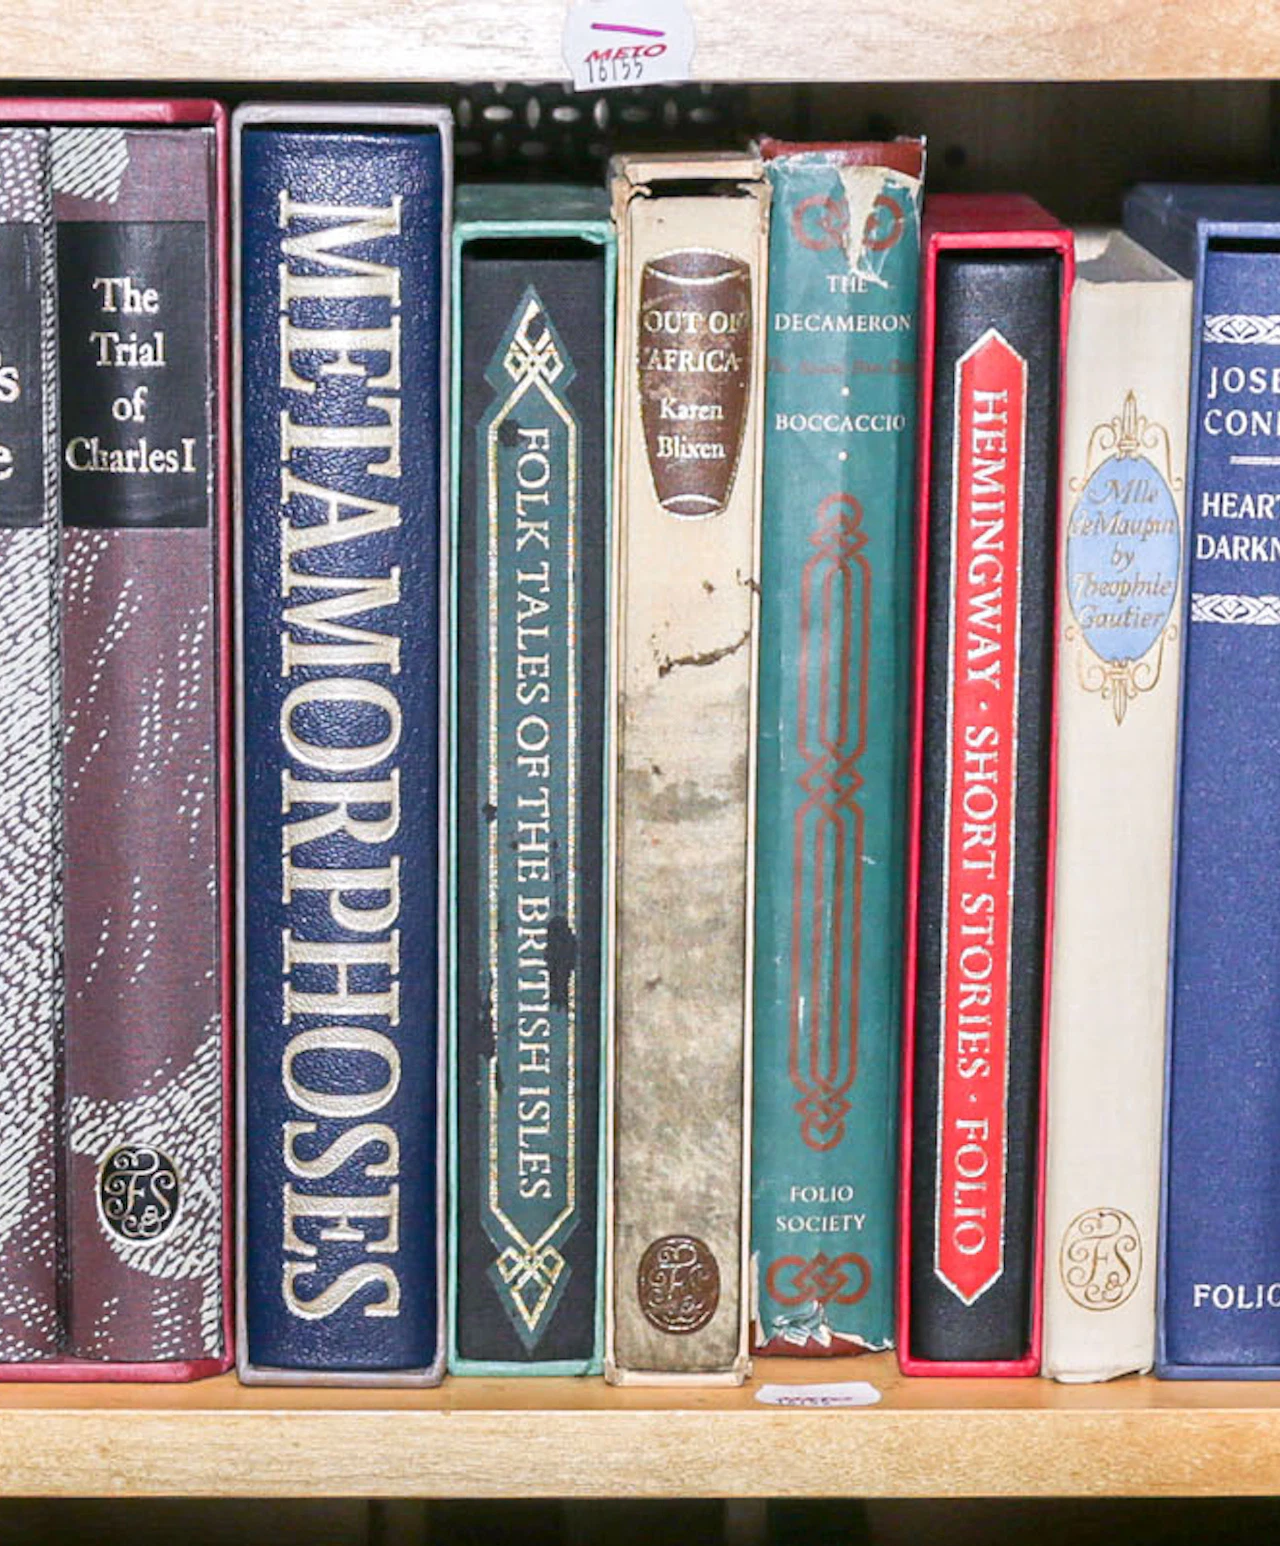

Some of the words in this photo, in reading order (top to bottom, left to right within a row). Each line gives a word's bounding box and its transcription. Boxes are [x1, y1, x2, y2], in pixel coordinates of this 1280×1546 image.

[584, 43, 667, 63] METO
[92, 277, 160, 315] The
[643, 310, 703, 333] OUT
[774, 312, 912, 333] DECAMERON
[89, 330, 165, 368] Trial
[647, 348, 743, 372] AFRICA
[111, 386, 147, 423] of
[660, 397, 724, 420] Karen
[775, 413, 906, 432] BOCCACCIO
[65, 437, 178, 474] Charles
[656, 435, 726, 459] Blixen
[517, 427, 551, 551] FOLK
[964, 388, 1009, 693] HEMINGWAY
[1110, 541, 1136, 574] by
[517, 561, 551, 707] TALES
[279, 190, 403, 1320] METAMORPHOSES
[518, 714, 551, 780] OF
[960, 721, 1001, 881] SHORT
[518, 788, 551, 884] THE
[517, 894, 551, 1073] BRITISH
[954, 890, 995, 1082] STORIES
[518, 1085, 552, 1199] ISLES
[789, 1185, 854, 1205] FOLIO
[950, 1117, 990, 1258] FOLIO
[775, 1211, 868, 1235] SOCIETY
